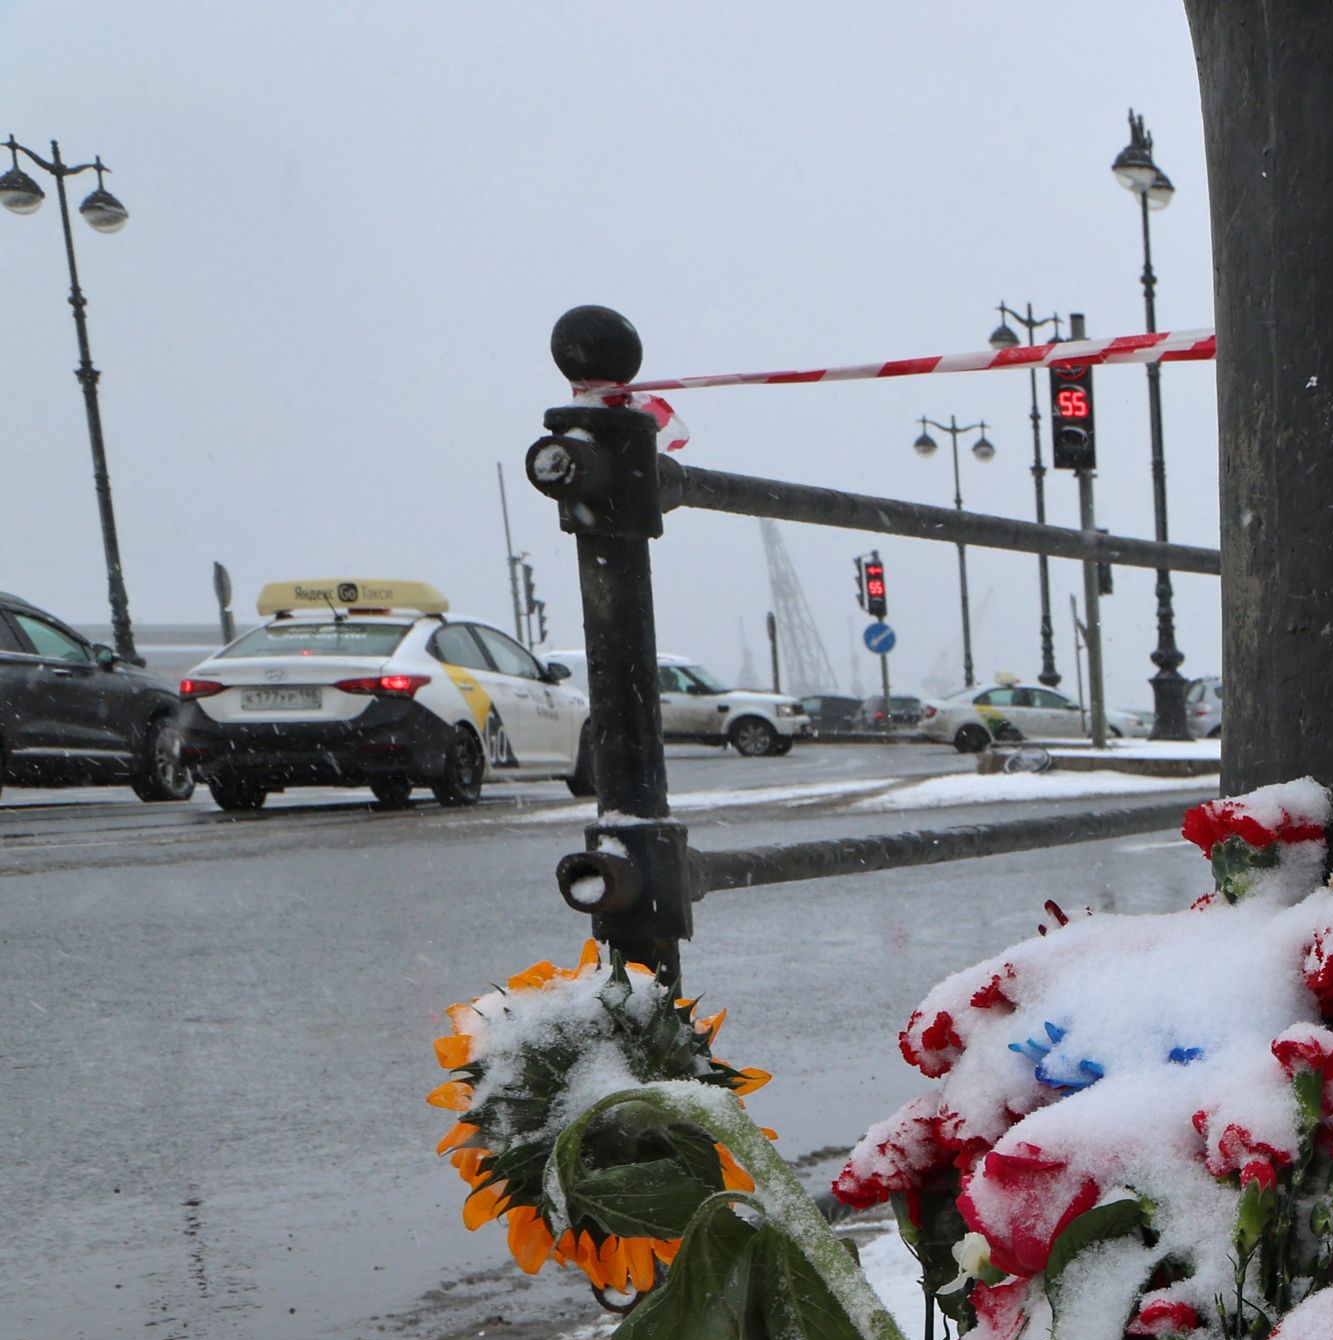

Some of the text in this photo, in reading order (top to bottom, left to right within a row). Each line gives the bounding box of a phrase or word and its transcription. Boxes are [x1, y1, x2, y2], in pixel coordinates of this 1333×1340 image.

[1059, 391, 1088, 417] 55
[294, 584, 393, 601] Яндекс Go Такси
[868, 581, 884, 596] 55
